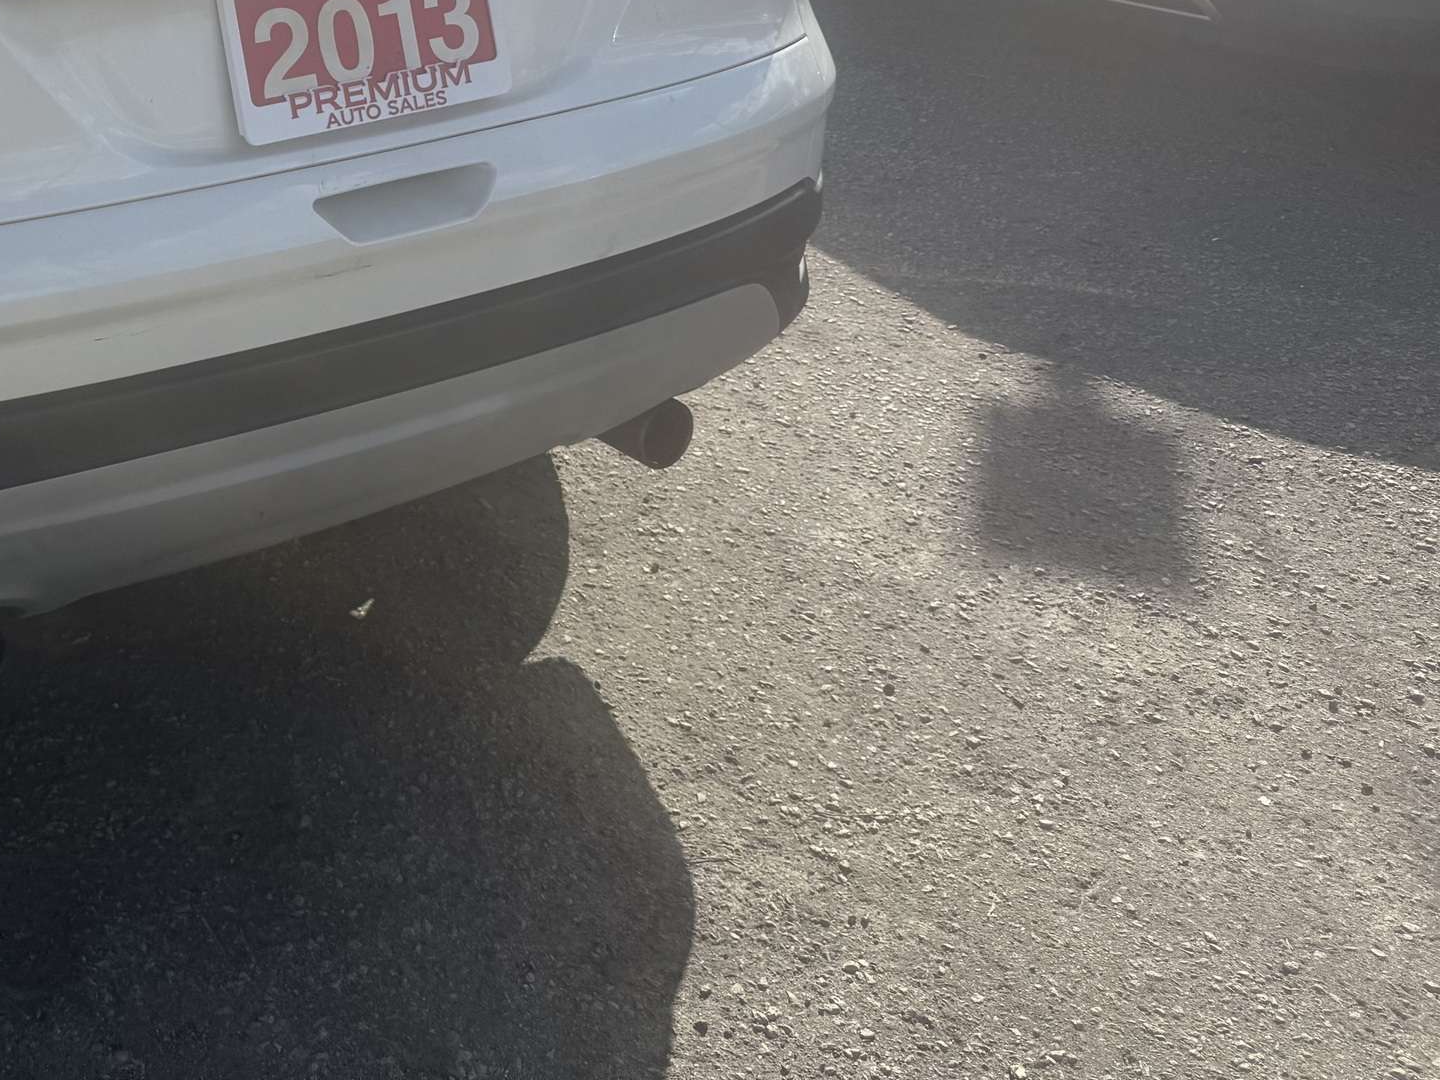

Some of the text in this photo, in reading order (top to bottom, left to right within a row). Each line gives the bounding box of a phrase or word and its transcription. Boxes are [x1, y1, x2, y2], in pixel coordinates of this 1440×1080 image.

[288, 62, 472, 120] PREMIUM
[326, 90, 448, 129] AUTO SALES
